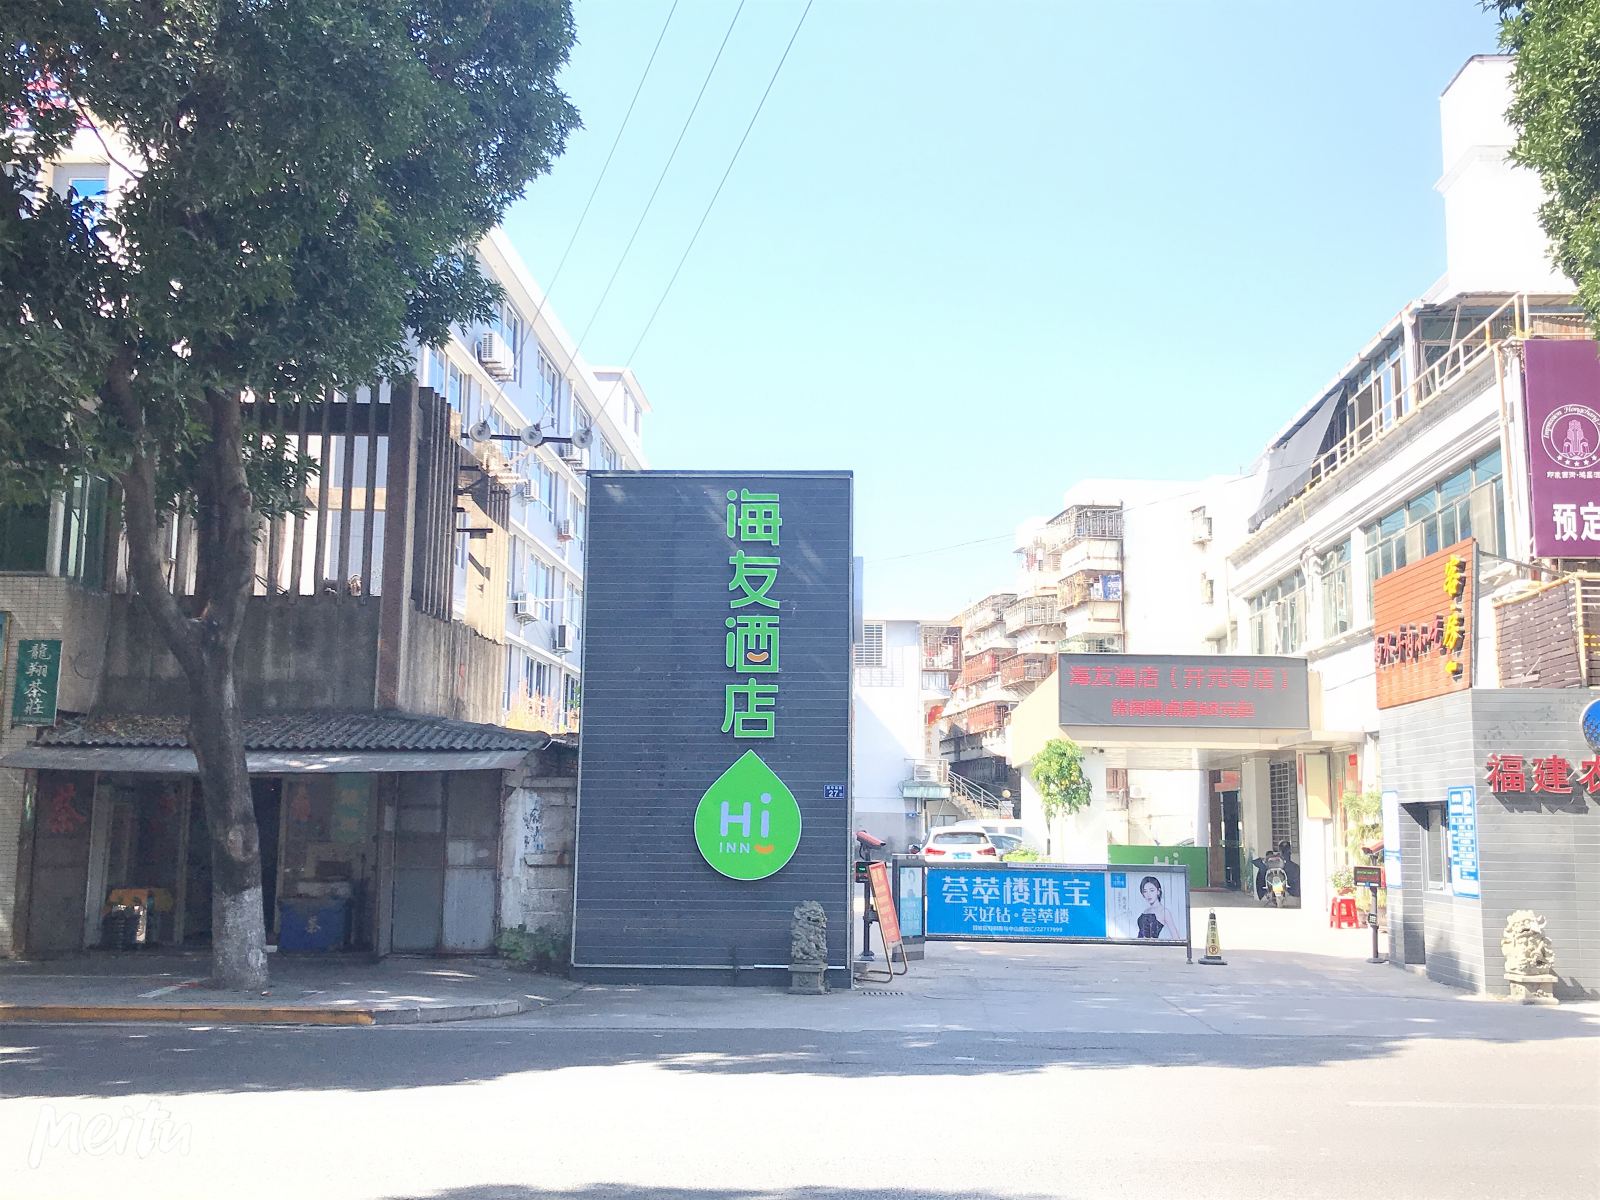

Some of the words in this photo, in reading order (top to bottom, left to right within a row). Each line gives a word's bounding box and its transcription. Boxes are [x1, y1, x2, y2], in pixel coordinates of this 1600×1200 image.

[1552, 501, 1600, 542] 预定
[721, 488, 782, 739] 海友酒店
[720, 792, 772, 838] Hi
[719, 842, 750, 854] INN
[941, 875, 1091, 907] 荟萃楼珠宝
